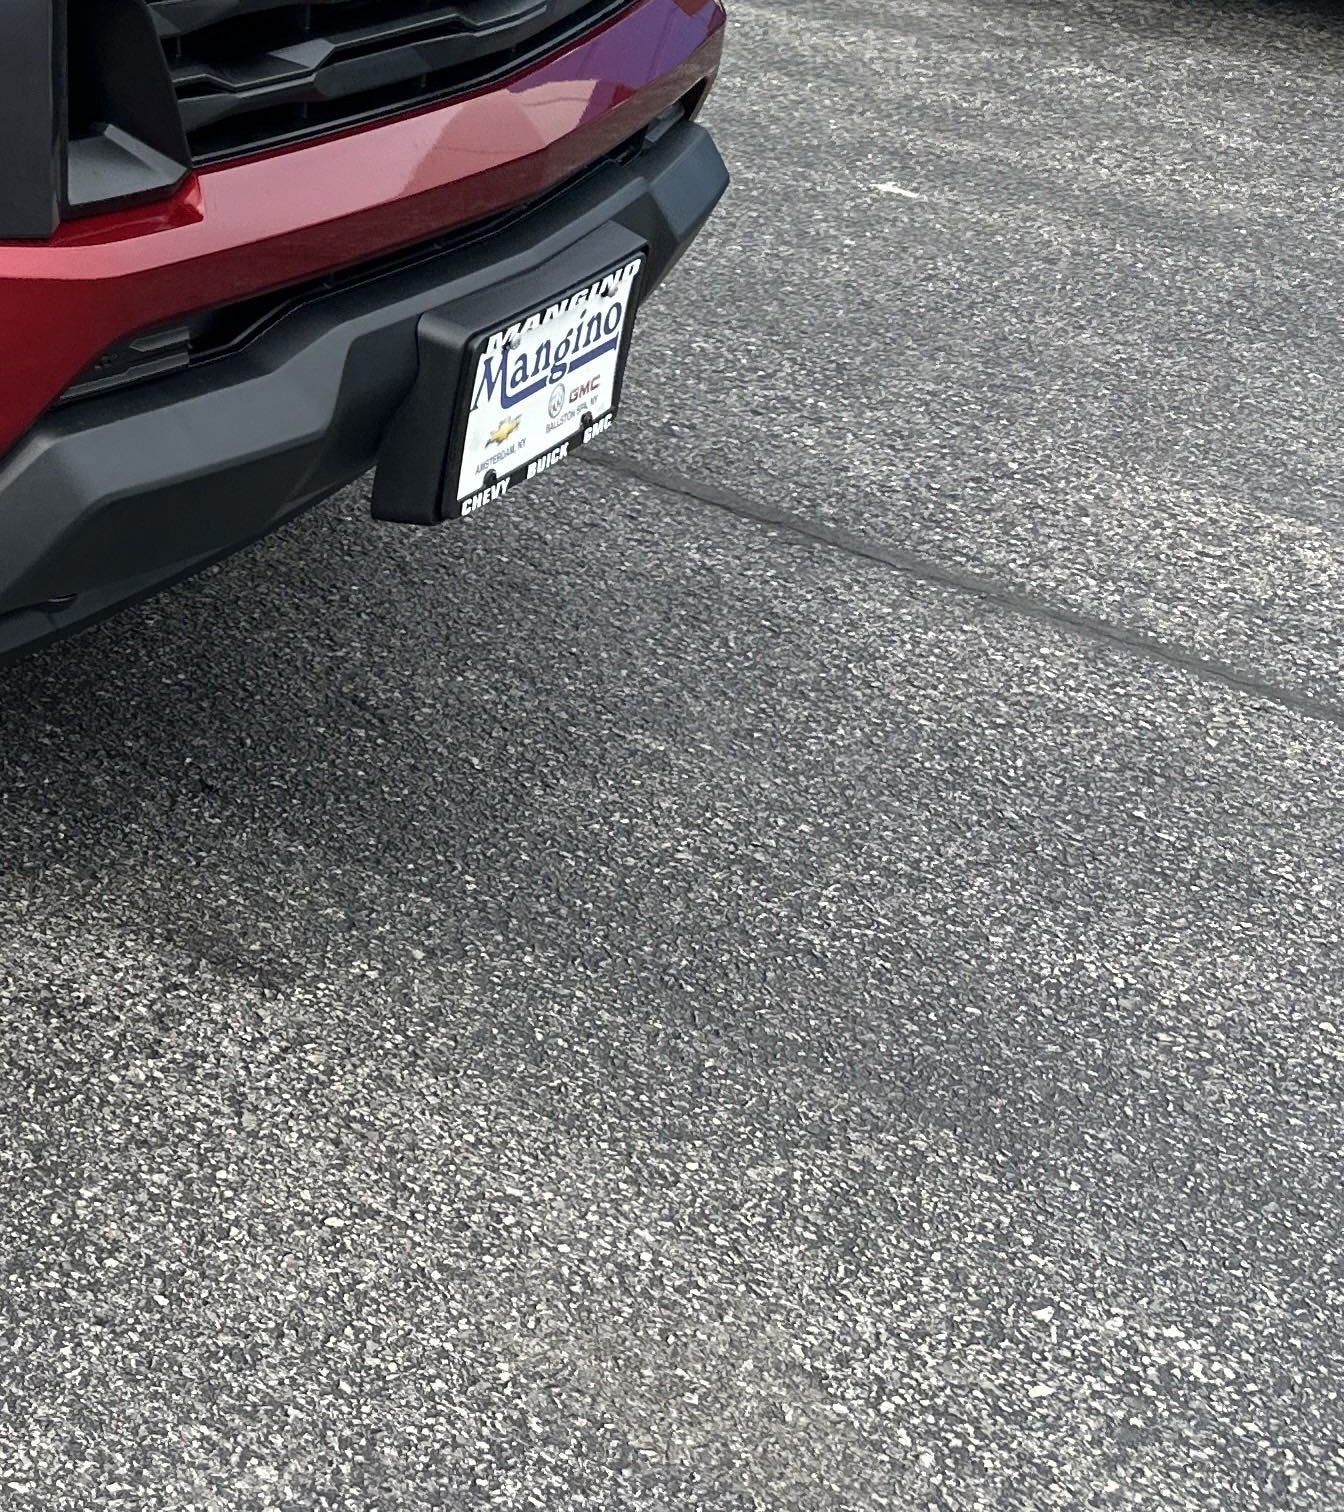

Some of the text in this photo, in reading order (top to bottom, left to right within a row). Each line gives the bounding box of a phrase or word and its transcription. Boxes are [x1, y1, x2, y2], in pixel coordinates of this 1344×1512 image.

[469, 301, 623, 411] Mangino
[486, 259, 642, 354] MANGINO
[569, 374, 601, 404] GMC
[461, 413, 613, 516] CHEVY BUICK GMC
